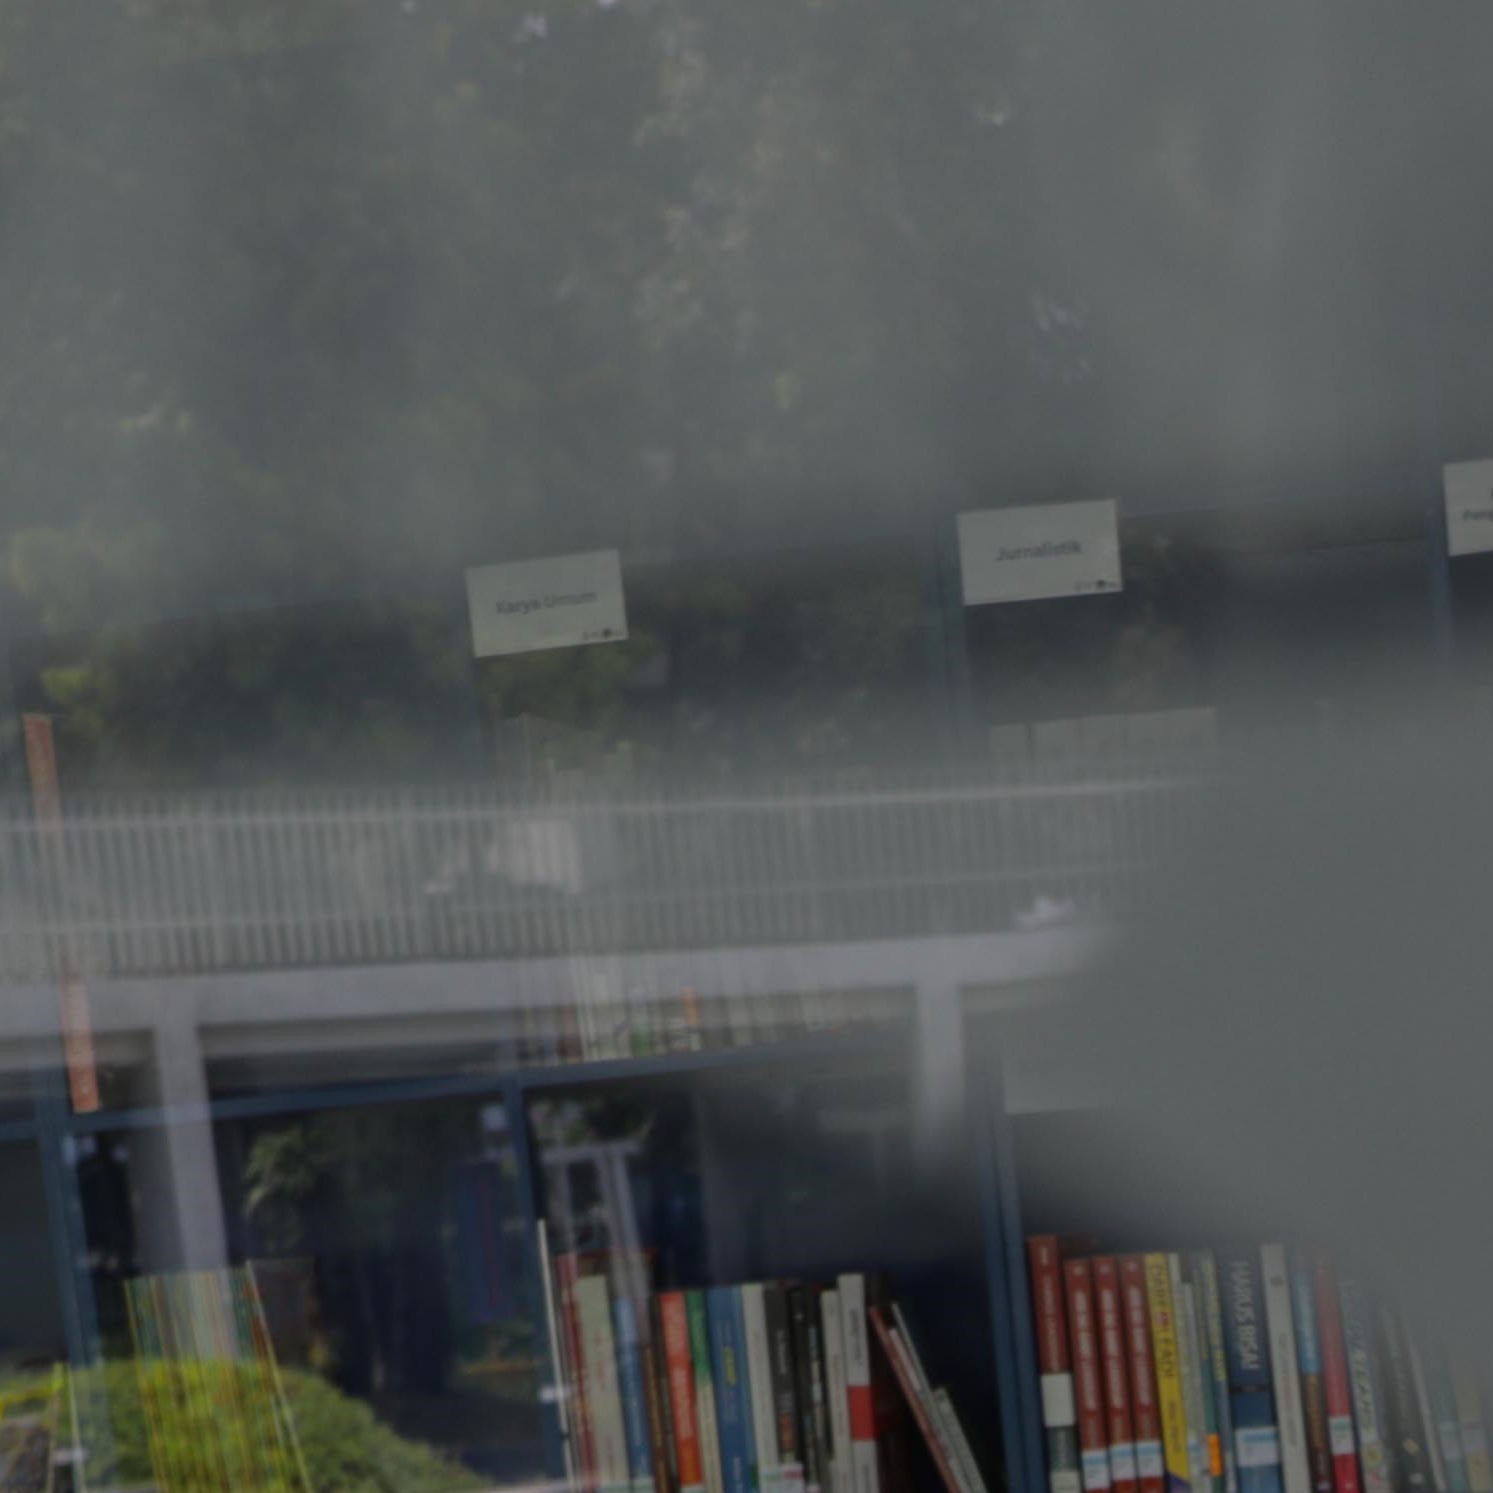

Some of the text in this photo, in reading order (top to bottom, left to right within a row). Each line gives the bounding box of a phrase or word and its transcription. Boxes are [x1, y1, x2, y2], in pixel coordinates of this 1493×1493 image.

[995, 540, 1082, 562] Jurnalistik
[496, 590, 597, 616] Karya Umum
[1229, 1260, 1260, 1370] HARUS BISA!
